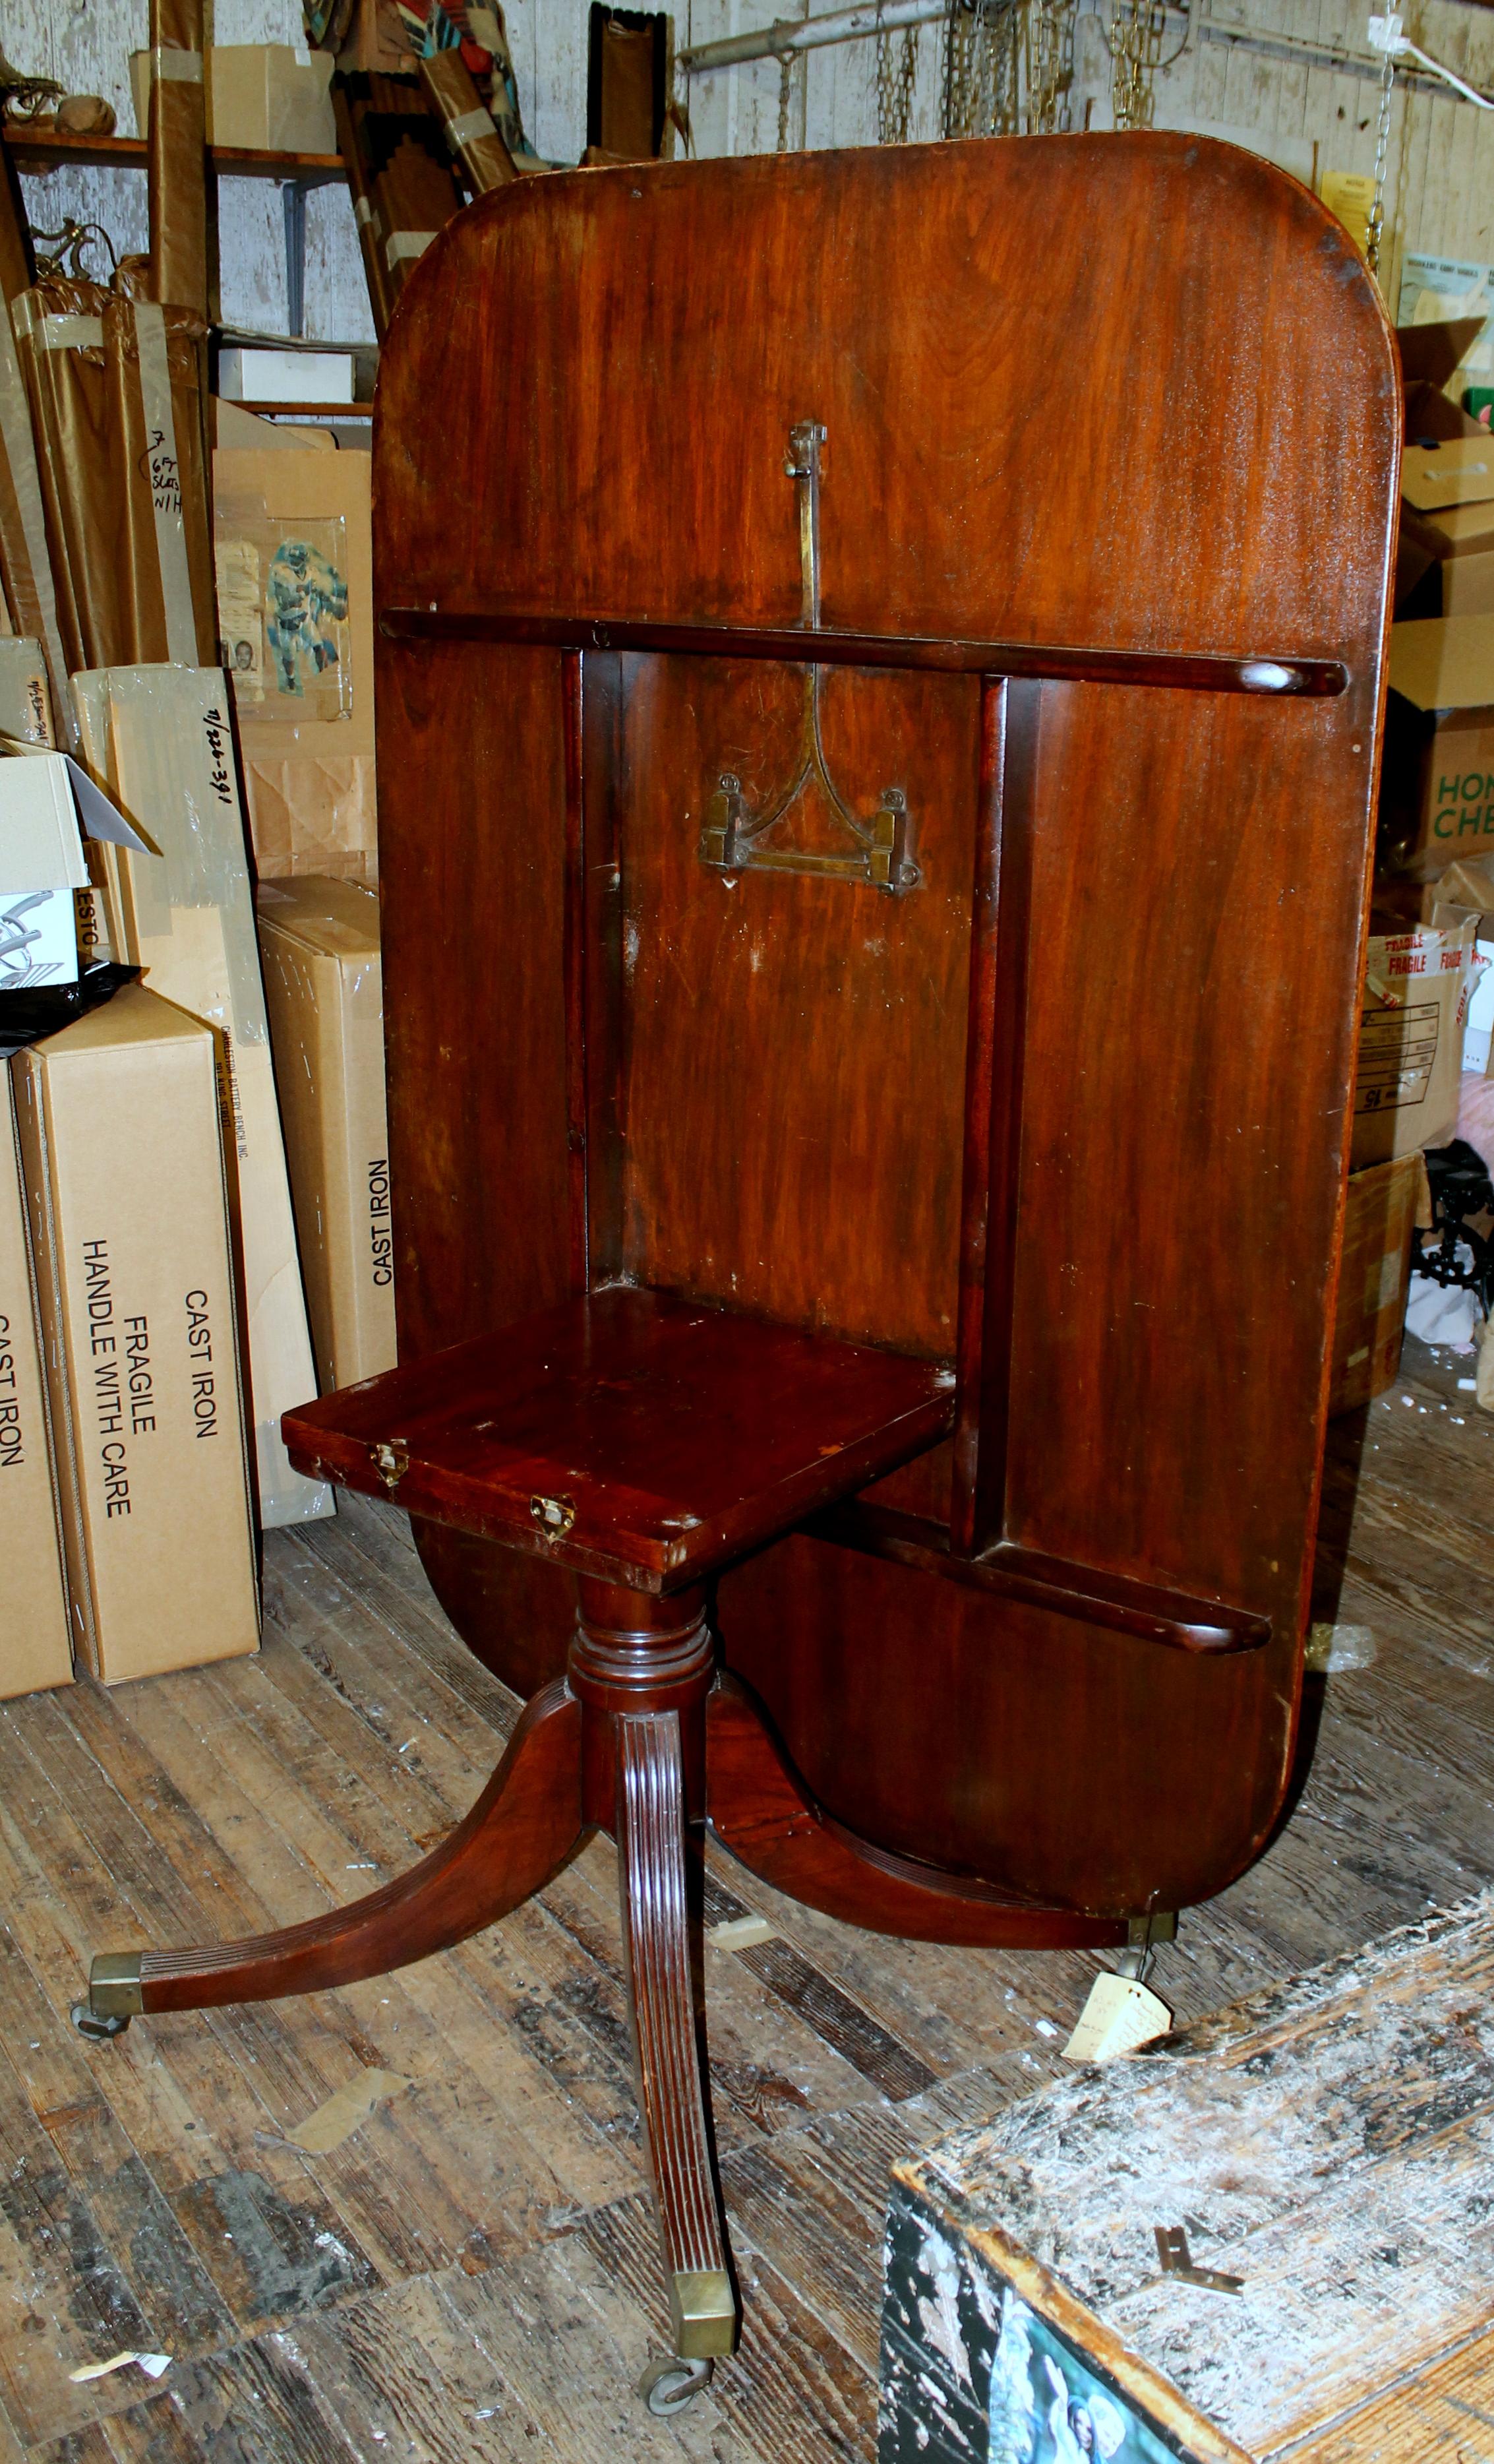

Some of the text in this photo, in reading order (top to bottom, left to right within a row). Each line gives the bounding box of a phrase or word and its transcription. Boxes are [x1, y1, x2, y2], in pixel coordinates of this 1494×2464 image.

[1389, 955, 1427, 975] FRAGILE
[221, 1025, 237, 1074] CHARLESTON
[220, 1101, 231, 1128] STREET
[227, 1077, 242, 1111] BATTERY
[233, 1115, 247, 1141] BENCH
[368, 1159, 392, 1286] CAST IRON
[83, 1239, 132, 1518] HANDLE WITH CARE
[124, 1316, 156, 1435] FRAGILE
[185, 1290, 218, 1438] CAST IRON
[0, 1398, 25, 1467] IRON
